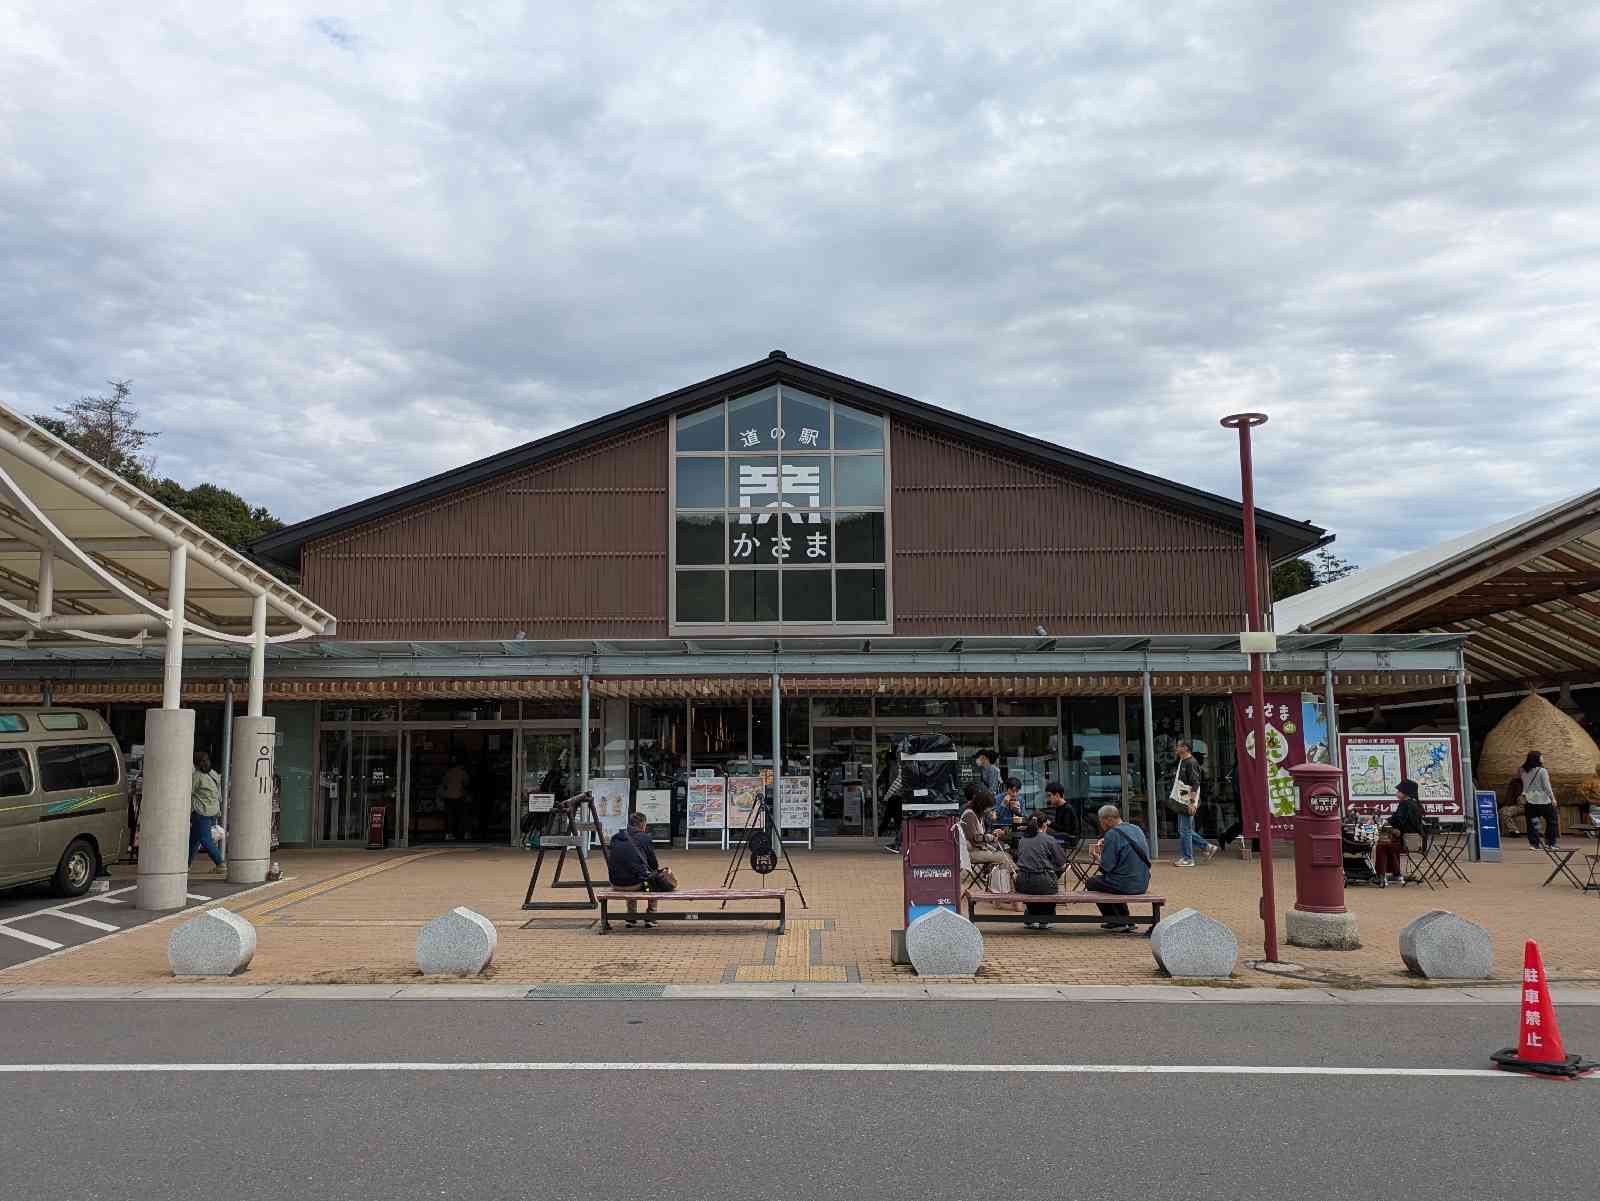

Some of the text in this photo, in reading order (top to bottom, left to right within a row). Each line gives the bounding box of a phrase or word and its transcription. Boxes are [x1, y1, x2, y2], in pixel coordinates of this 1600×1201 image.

[739, 427, 820, 447] 道の駅
[733, 531, 829, 558] かさま
[1524, 968, 1544, 1048] 駐車禁止
